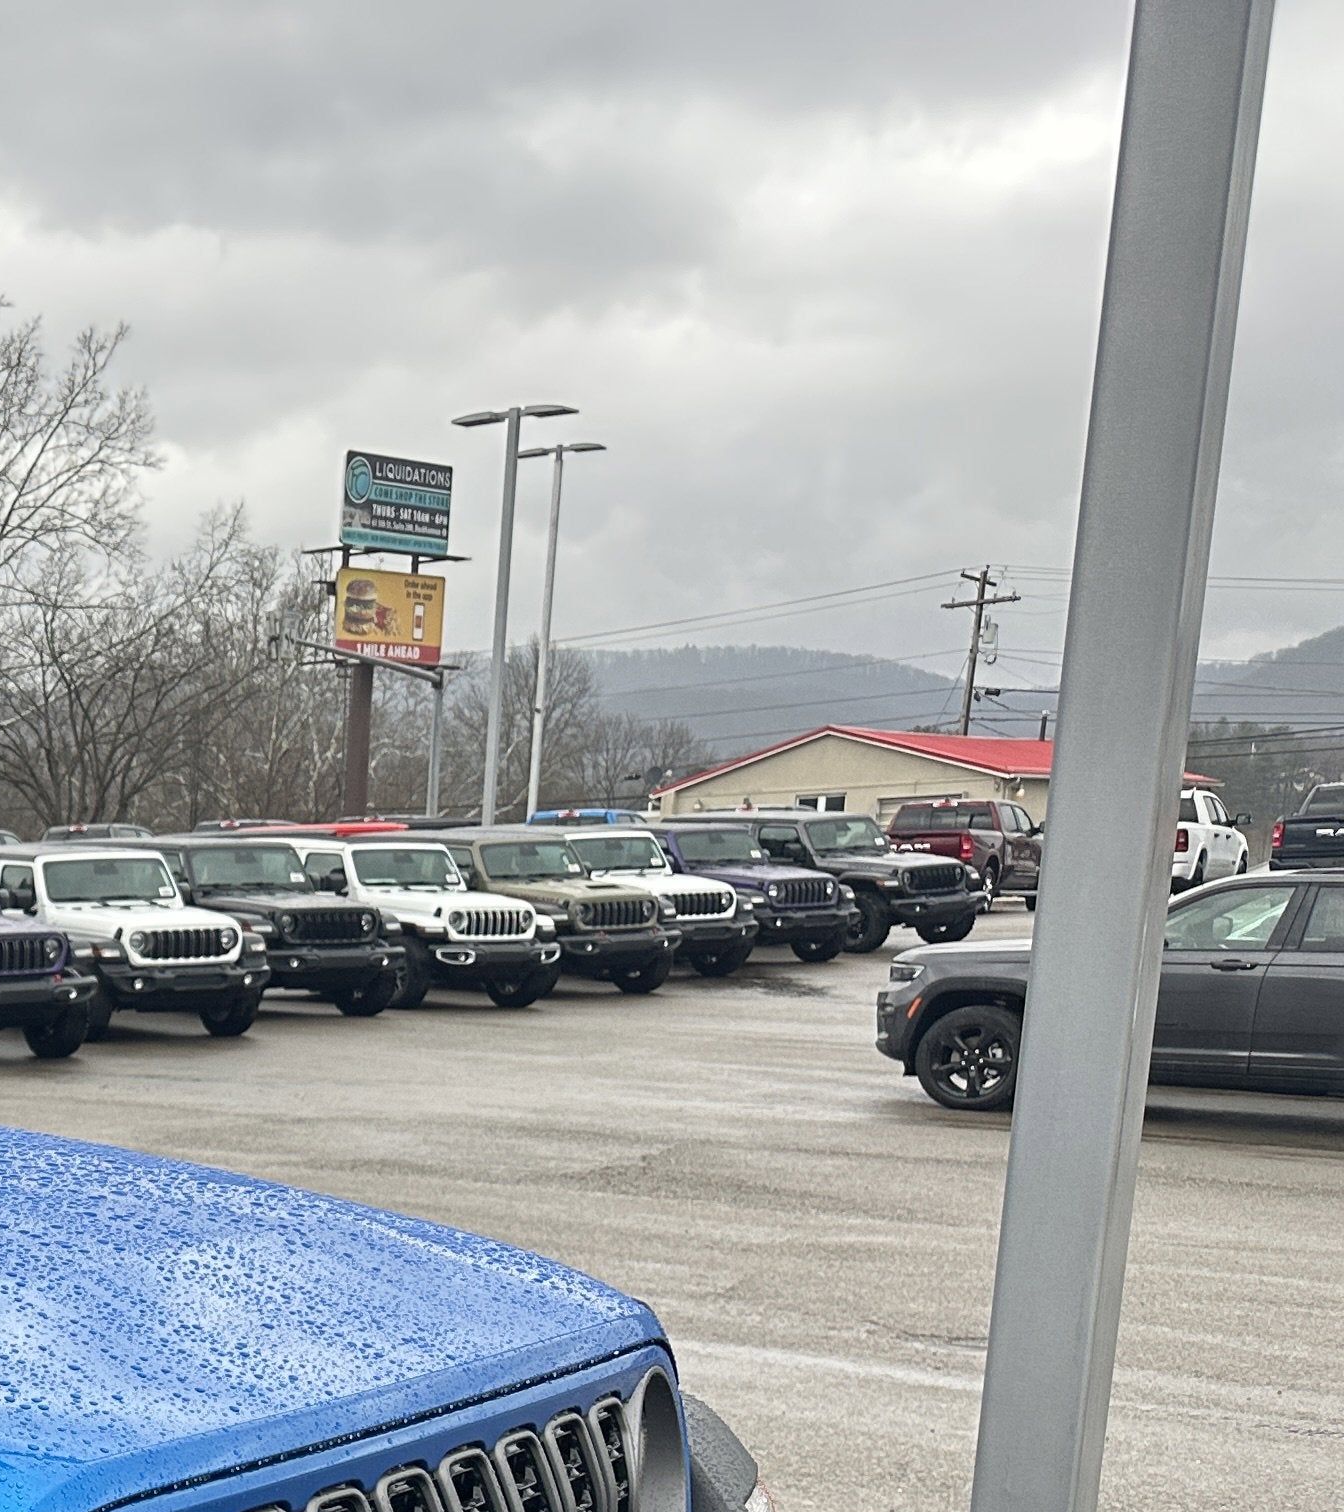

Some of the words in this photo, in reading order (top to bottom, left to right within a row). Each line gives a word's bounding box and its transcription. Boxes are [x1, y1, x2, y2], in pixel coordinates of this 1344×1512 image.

[375, 461, 451, 488] LIQUIDATIONS
[374, 487, 393, 499] COME
[395, 490, 413, 502] SHOP
[415, 492, 427, 504] THE
[428, 494, 450, 507] STORE
[372, 503, 395, 518] THURS
[399, 507, 412, 521] SAT
[356, 643, 362, 655] 1
[363, 643, 387, 657] MILE
[388, 644, 420, 660] AHEAD
